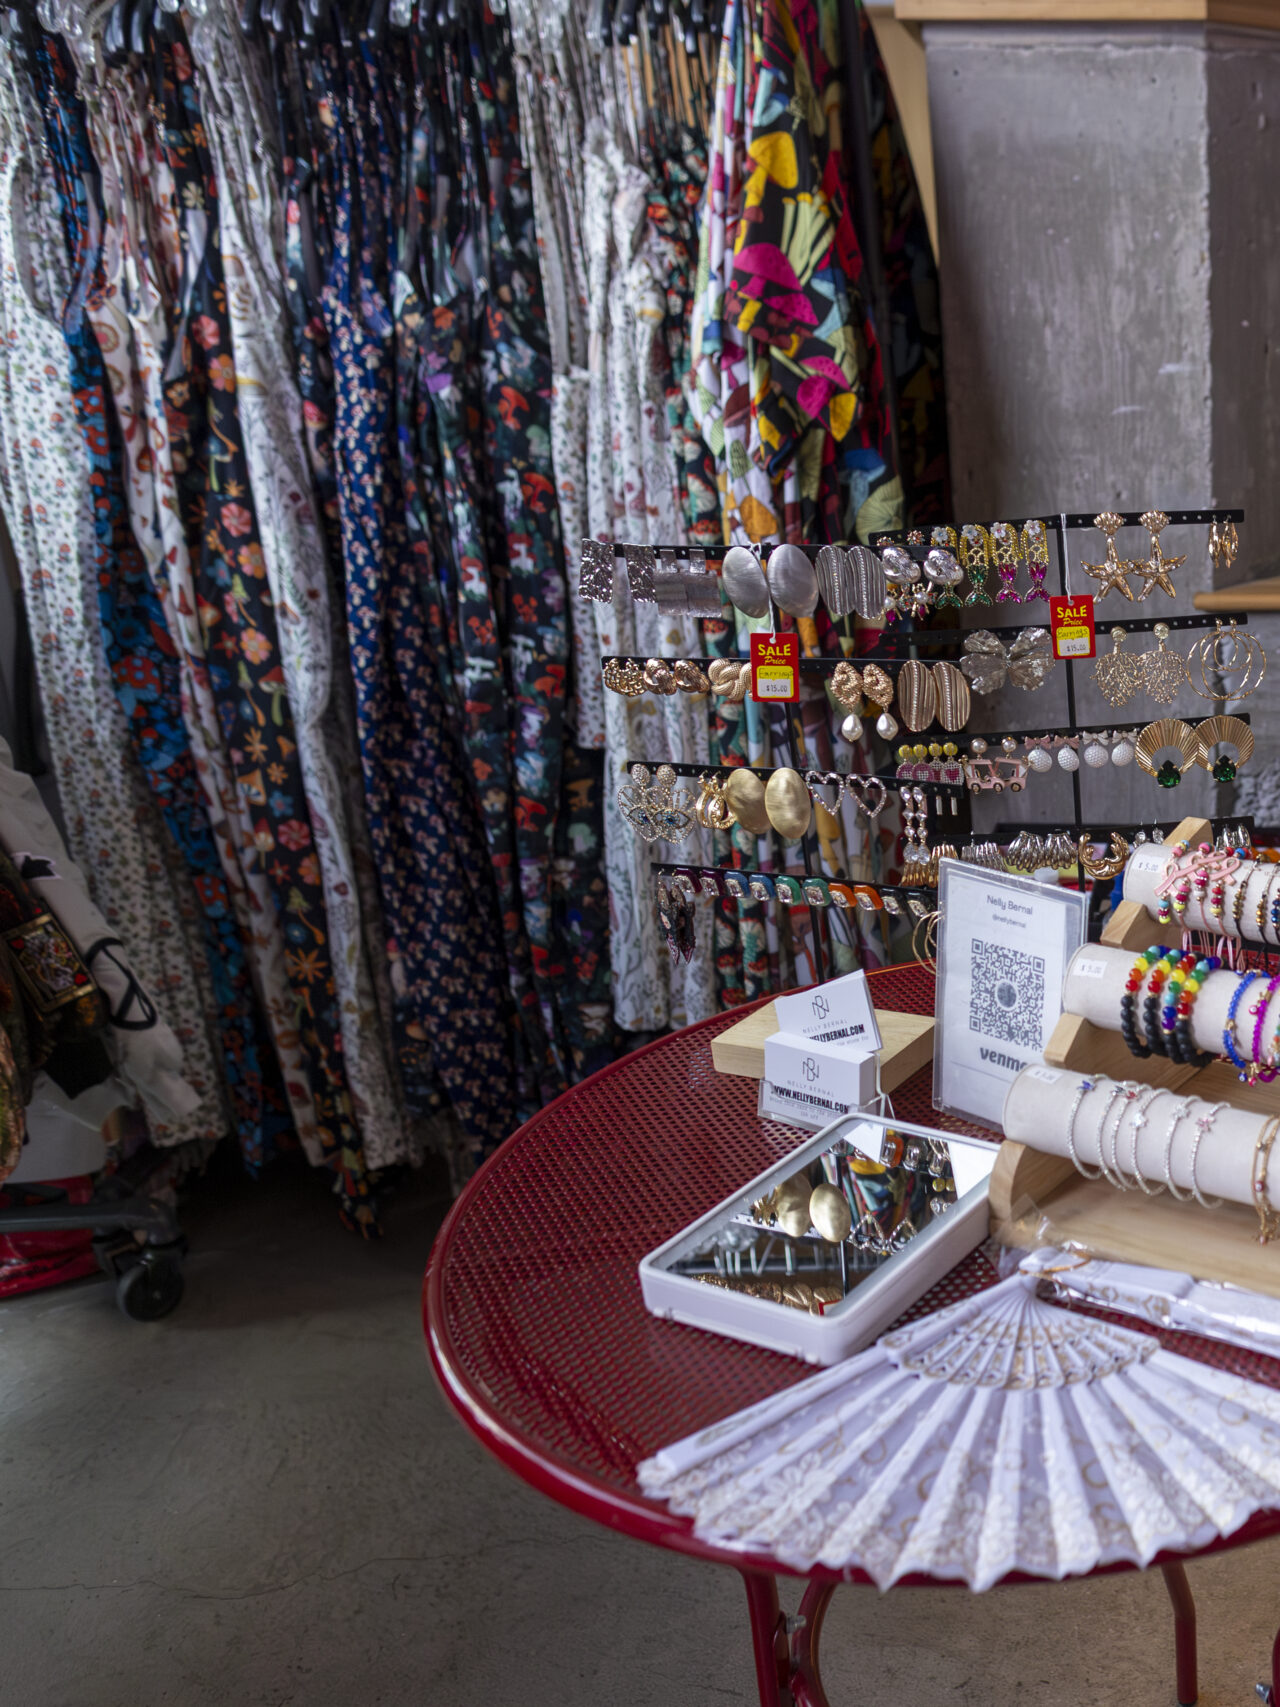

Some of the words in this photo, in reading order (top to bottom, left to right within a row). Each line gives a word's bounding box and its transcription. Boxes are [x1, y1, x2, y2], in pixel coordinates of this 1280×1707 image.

[1056, 604, 1087, 618] SALE
[1063, 617, 1083, 626] Price
[758, 643, 791, 656] SALE
[764, 655, 786, 665] Price
[766, 684, 788, 693] $15.00
[986, 894, 1006, 911] Nelly
[1007, 900, 1033, 915] Bernal
